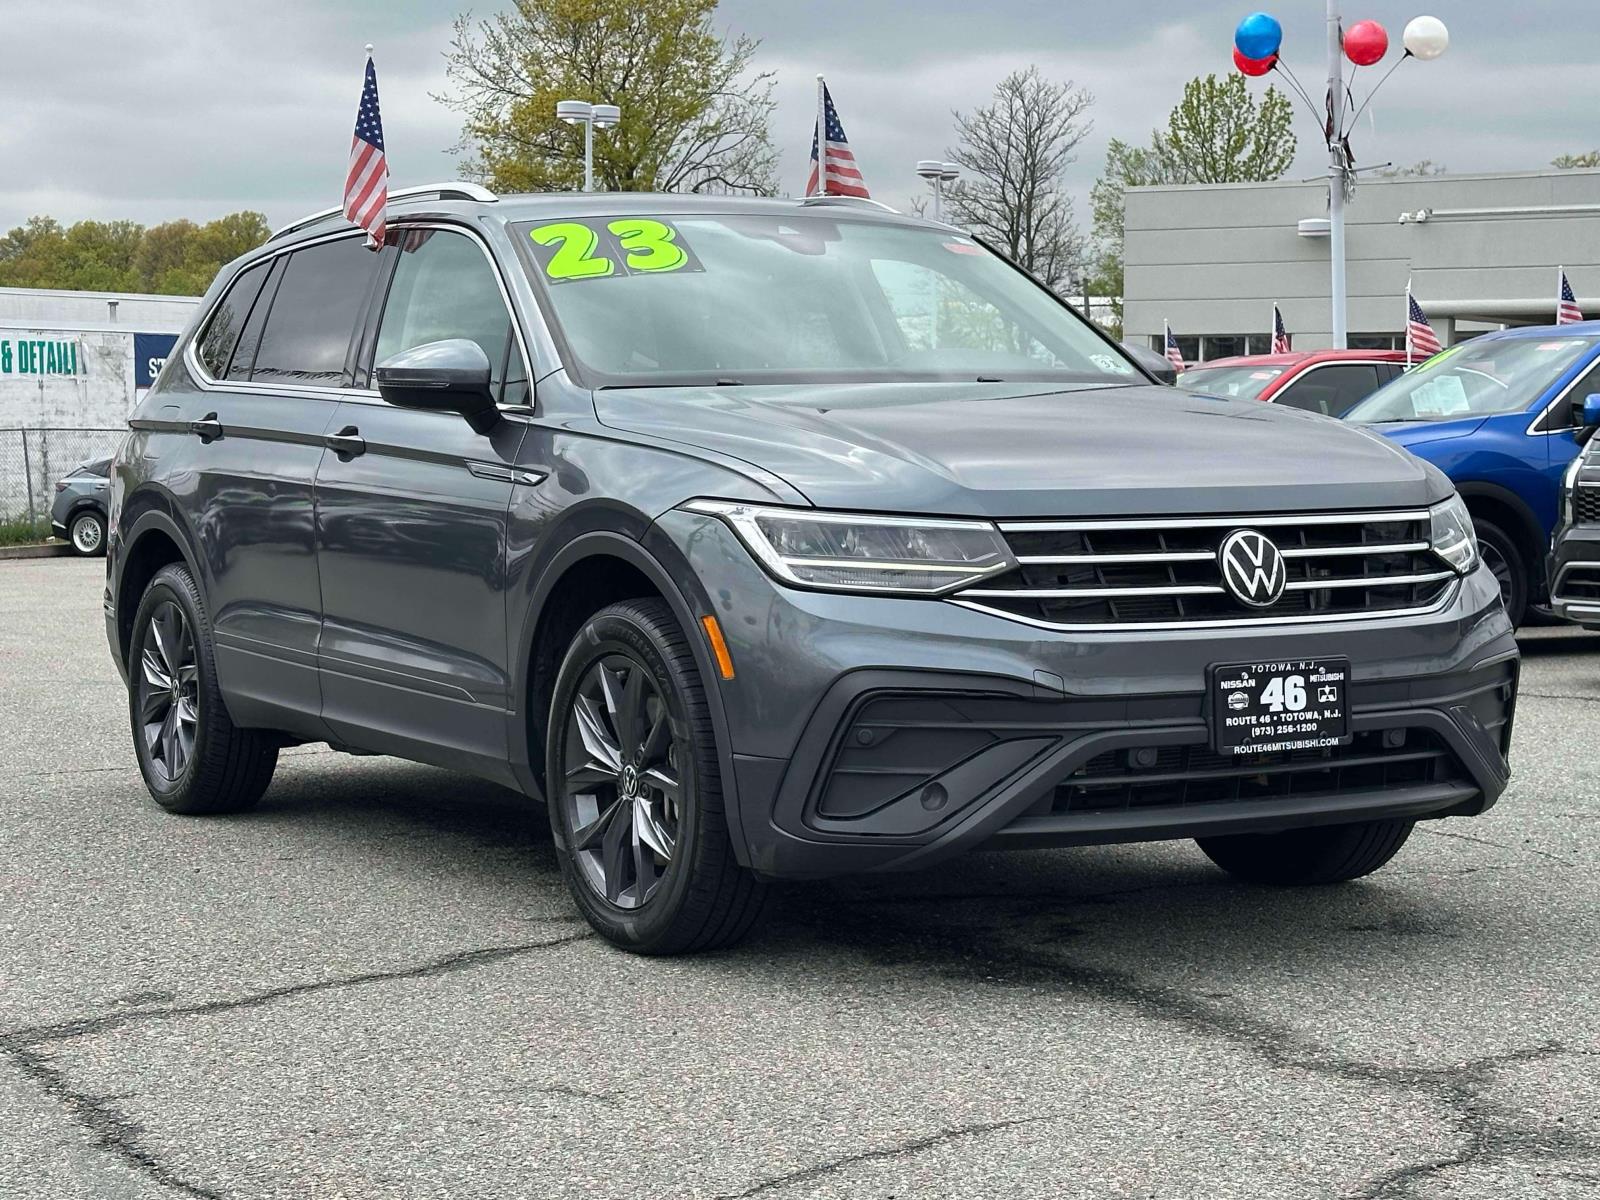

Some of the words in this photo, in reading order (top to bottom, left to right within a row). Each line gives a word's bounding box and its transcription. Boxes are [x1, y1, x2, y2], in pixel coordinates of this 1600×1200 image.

[530, 219, 688, 279] 23
[2, 340, 12, 374] &
[1299, 661, 1318, 670] N.J.
[1220, 679, 1256, 689] NISSAN
[1310, 672, 1344, 683] MITSUBISHI
[1260, 675, 1307, 712] 46
[1226, 715, 1257, 726] ROUTE
[1259, 714, 1271, 723] 46
[1280, 712, 1322, 722] TOTOWA,
[1324, 709, 1341, 718] N.J.
[1252, 726, 1274, 737] (973)
[1277, 723, 1317, 734] 256-1200
[1234, 738, 1339, 754] ROUTE46MITSUBISHI.COM
